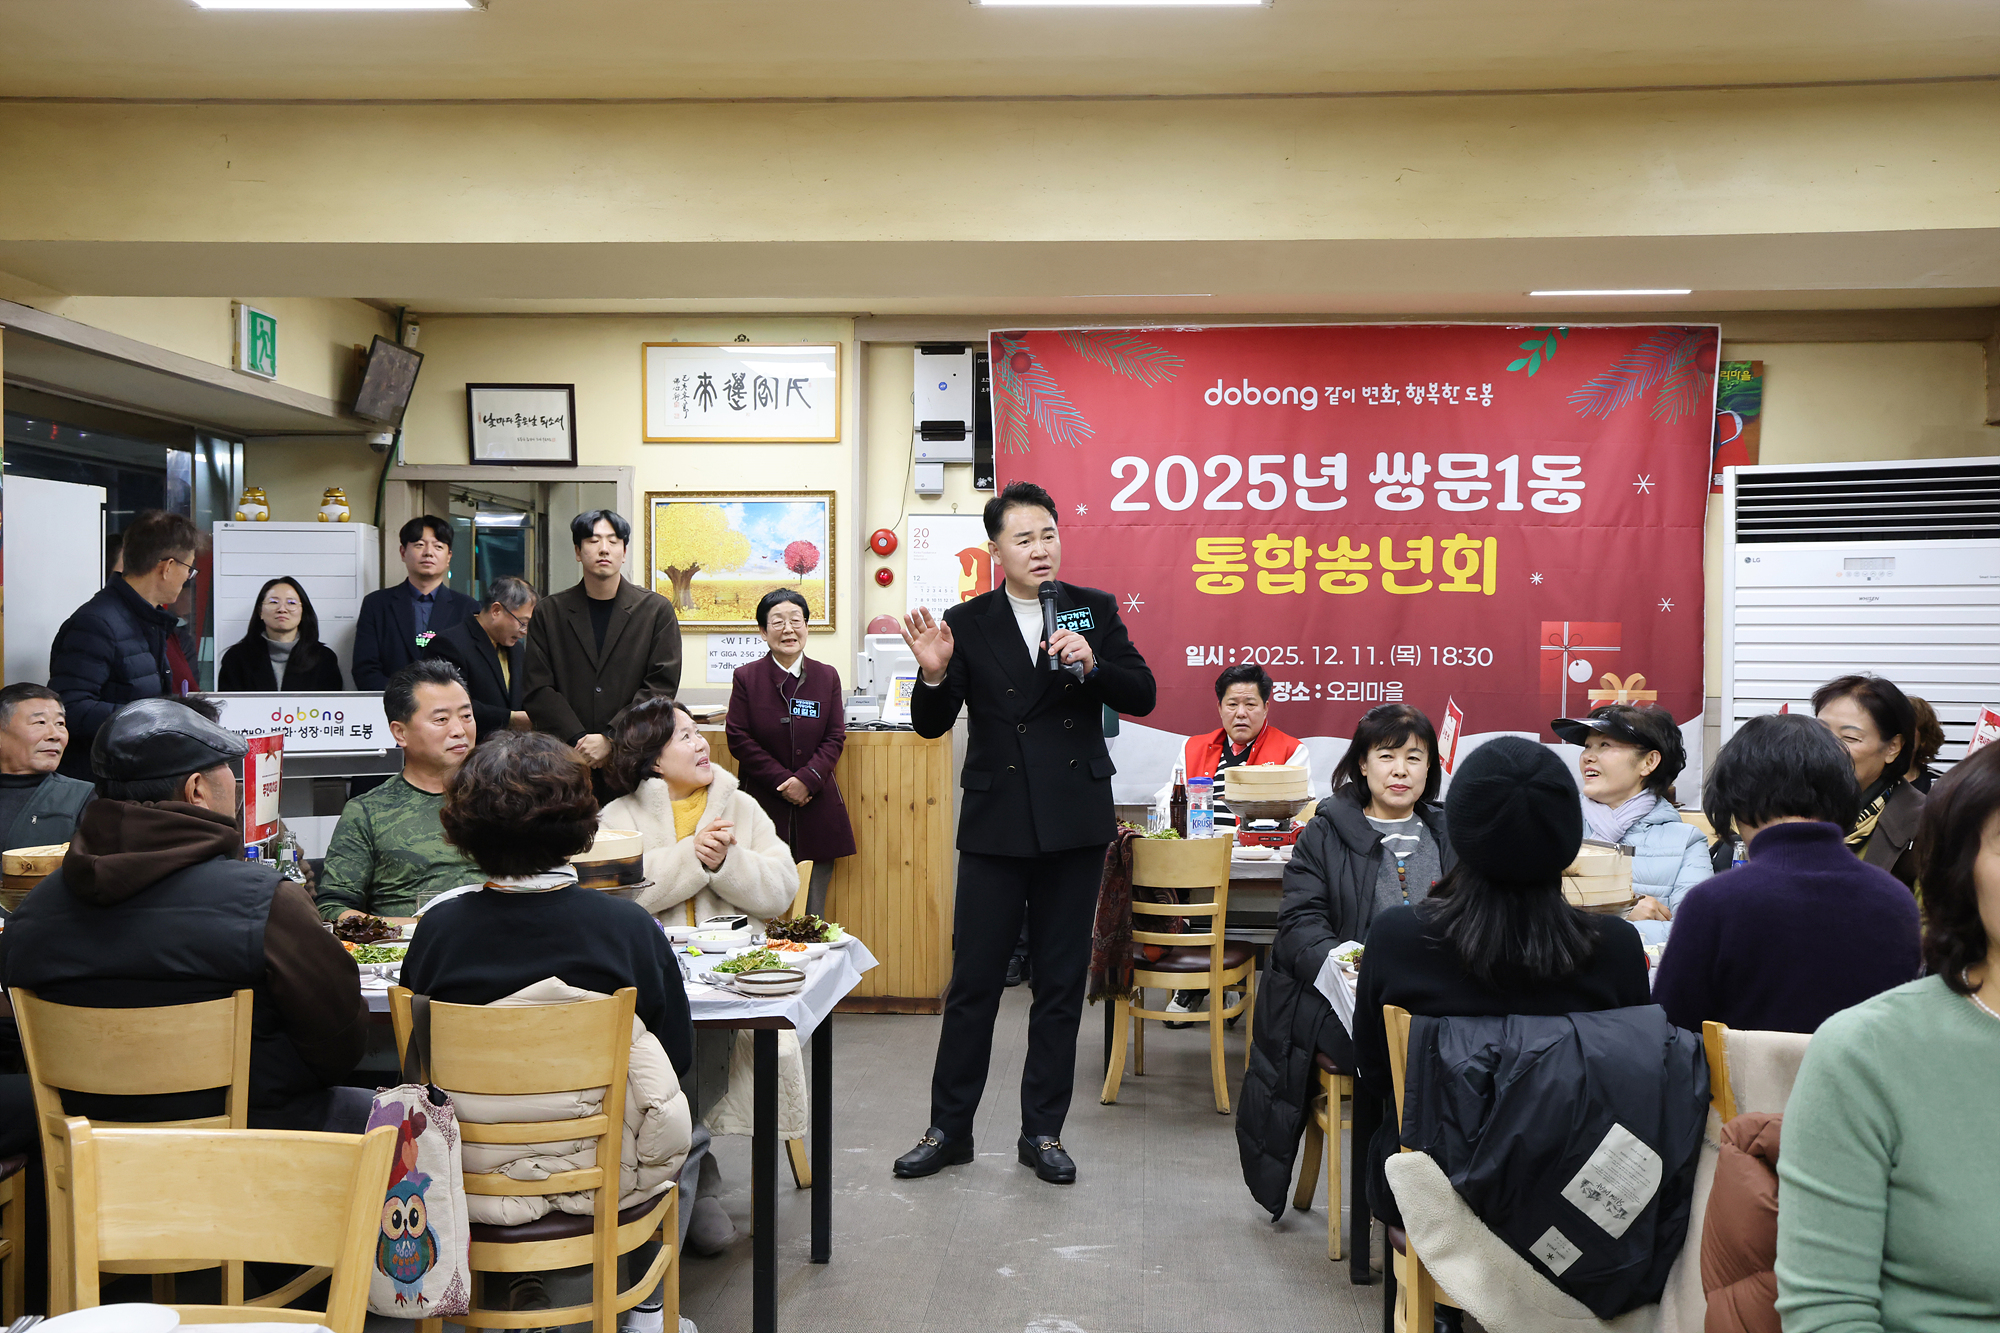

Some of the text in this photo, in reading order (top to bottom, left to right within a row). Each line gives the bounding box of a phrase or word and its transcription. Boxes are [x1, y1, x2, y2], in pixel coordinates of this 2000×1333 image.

[1720, 370, 1752, 381] 리마을
[1204, 378, 1494, 411] dobong 같이 변화, 행복한 도봉
[483, 413, 513, 428] 날마다
[540, 415, 565, 431] 되소서
[1110, 452, 1587, 514] 2025년 쌍문1동
[914, 527, 930, 538] 20
[914, 539, 930, 549] 26
[1192, 533, 1498, 596] 통합송년회
[1240, 645, 1304, 666] 2025.
[1312, 646, 1344, 666] 12.
[1351, 646, 1384, 666] 11.
[1390, 645, 1421, 667] (목)
[1430, 646, 1494, 667] 18:30
[1326, 681, 1404, 703] 오리마을
[271, 707, 345, 724] dobong
[350, 724, 374, 740] 도봉
[1192, 818, 1213, 829] KRUSH
